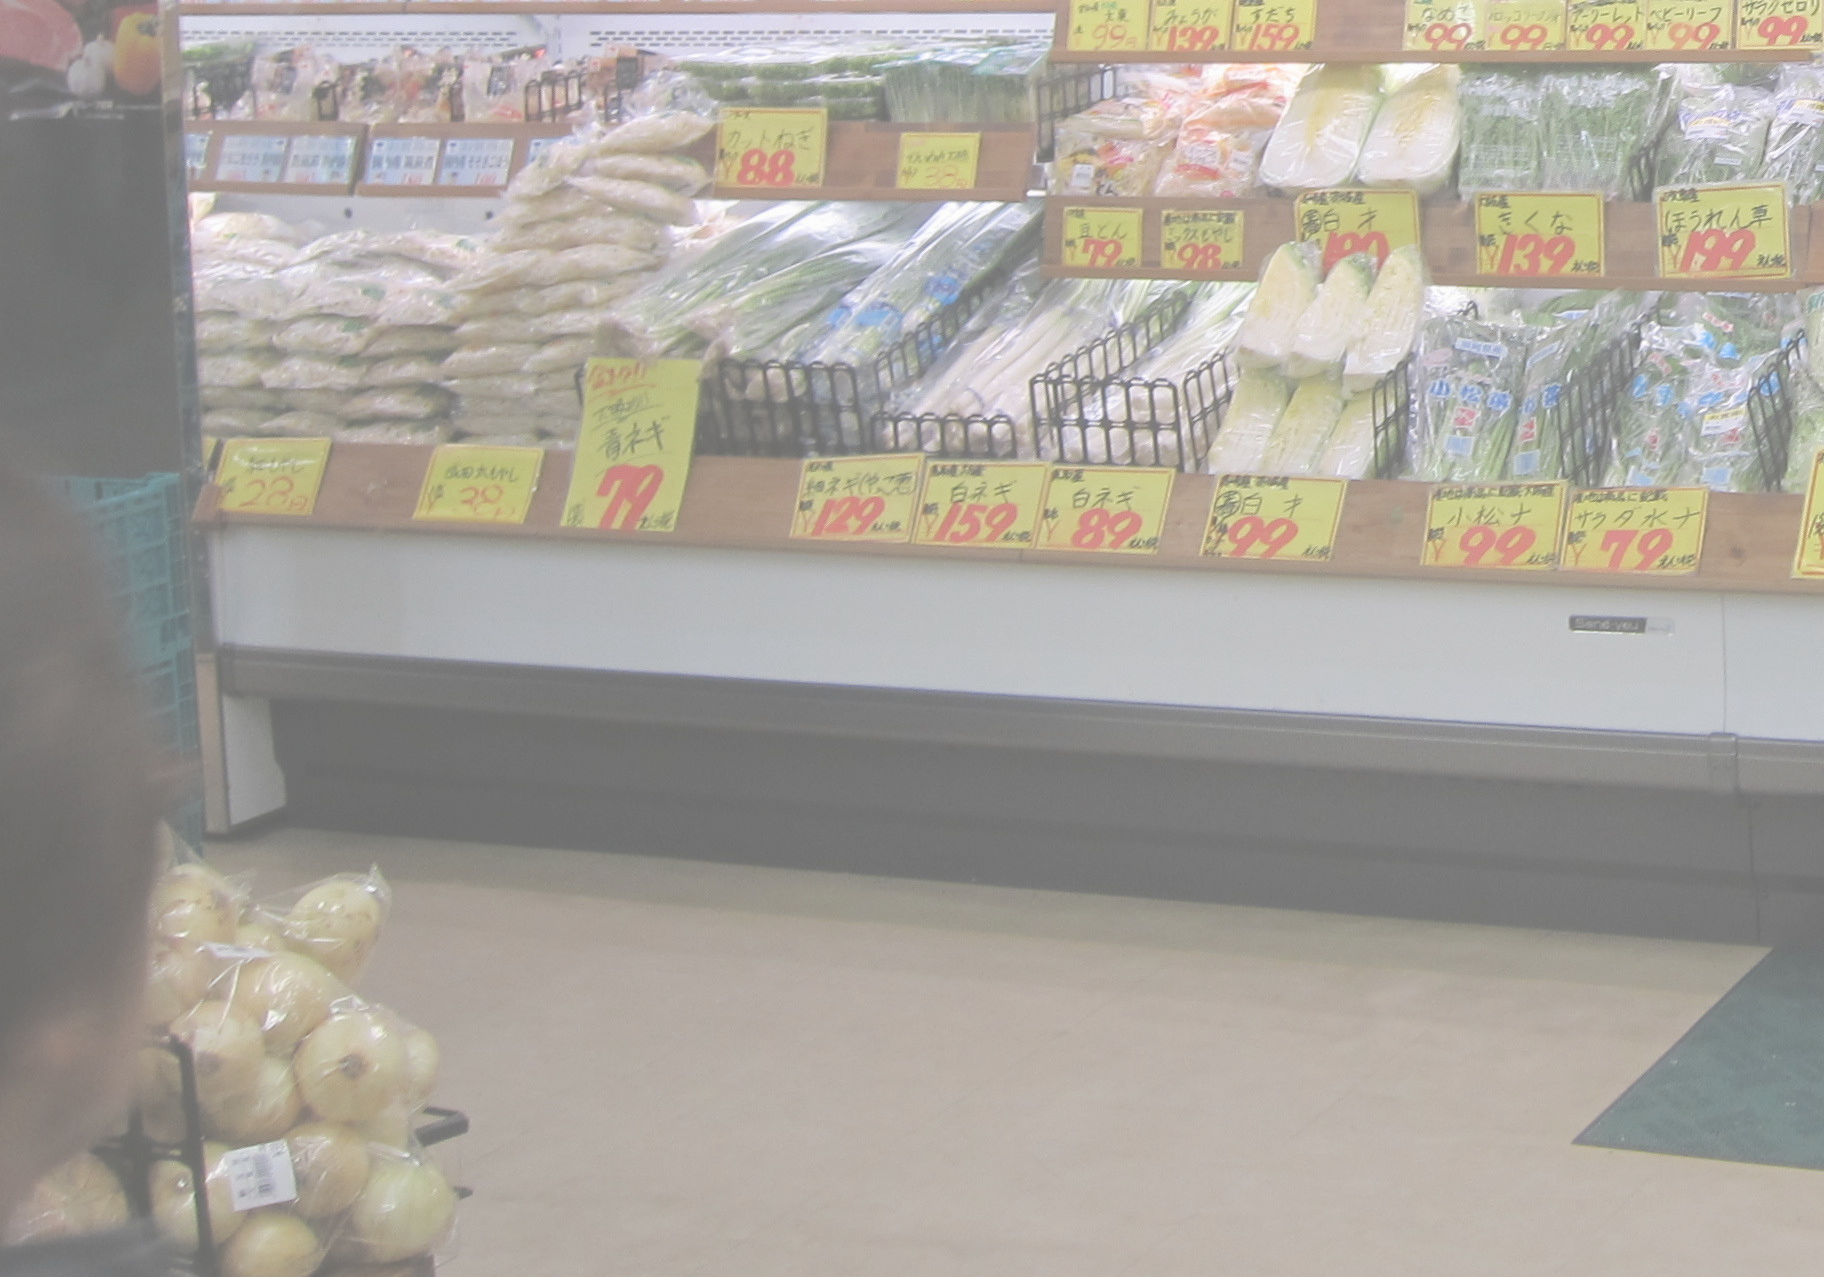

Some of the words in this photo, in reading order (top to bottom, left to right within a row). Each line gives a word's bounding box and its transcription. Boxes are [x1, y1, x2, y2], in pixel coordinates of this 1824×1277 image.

[1166, 25, 1221, 52] 139
[1248, 23, 1301, 52] 159
[1424, 23, 1473, 51] 99
[1500, 24, 1549, 51] 99
[1586, 23, 1636, 51] 99
[1667, 22, 1722, 51] 99
[1756, 15, 1810, 47] 99
[726, 125, 815, 151] カットねぎ
[736, 148, 797, 186] 88
[1497, 210, 1574, 235] きくな
[1664, 204, 1773, 233] ほうれん草
[1081, 238, 1125, 268] 79
[1176, 243, 1224, 270] 98
[1499, 234, 1577, 275] 139
[1680, 228, 1757, 273] 199
[598, 416, 672, 461] 青ネギ
[595, 464, 665, 530] 79
[949, 479, 1019, 505] 白ネギ
[1071, 485, 1142, 511] 白ネギ
[810, 496, 886, 537] 129
[932, 502, 1019, 544] 159
[1070, 508, 1144, 550] 89
[1228, 515, 1300, 559] 99
[1458, 525, 1537, 567] 99
[1600, 528, 1674, 571] 79
